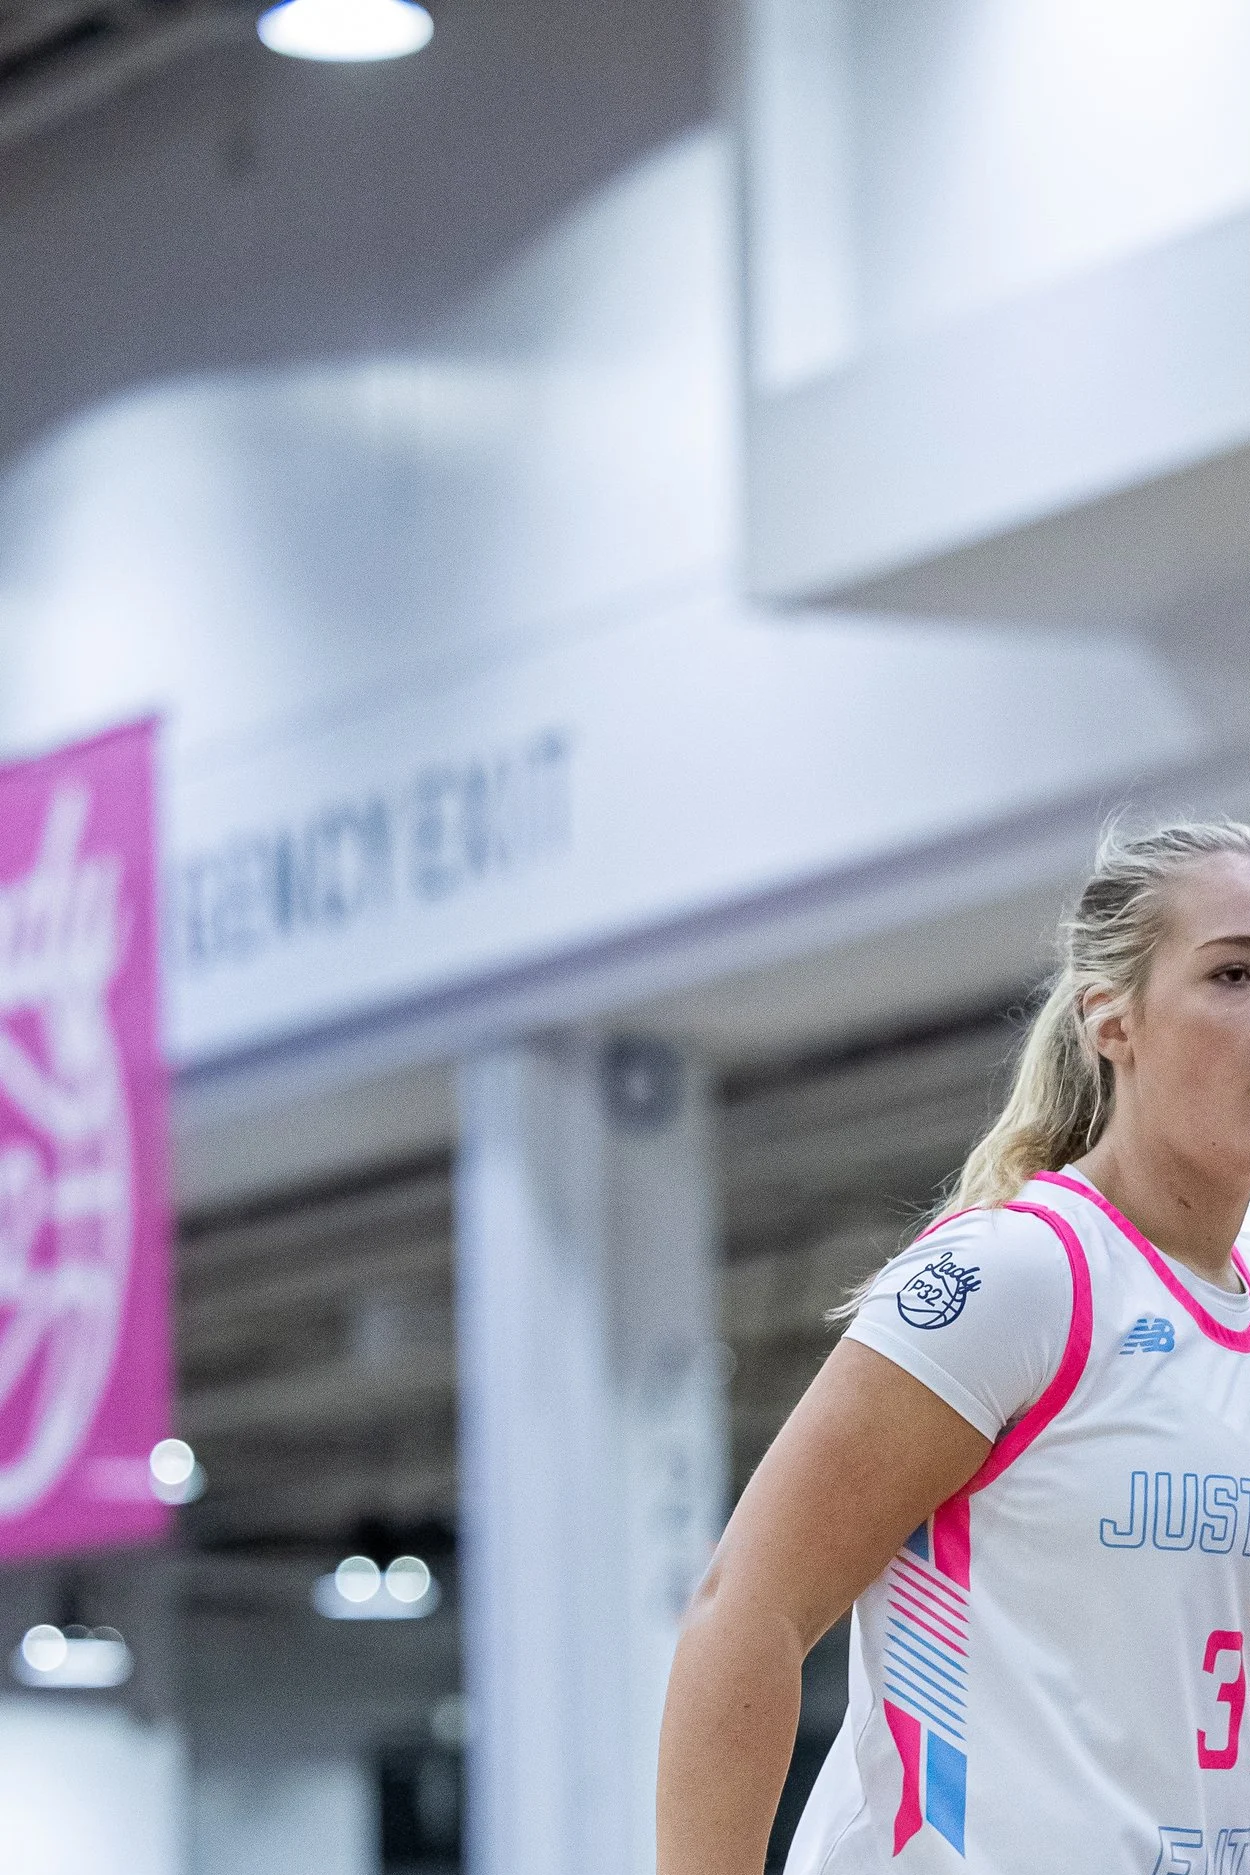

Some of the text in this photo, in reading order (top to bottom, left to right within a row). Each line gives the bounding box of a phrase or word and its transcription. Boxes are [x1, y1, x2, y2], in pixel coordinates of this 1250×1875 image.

[406, 725, 575, 904] EXIT
[908, 1279, 943, 1308] P32
[924, 1251, 982, 1295] Lady
[1118, 1317, 1176, 1356] NB
